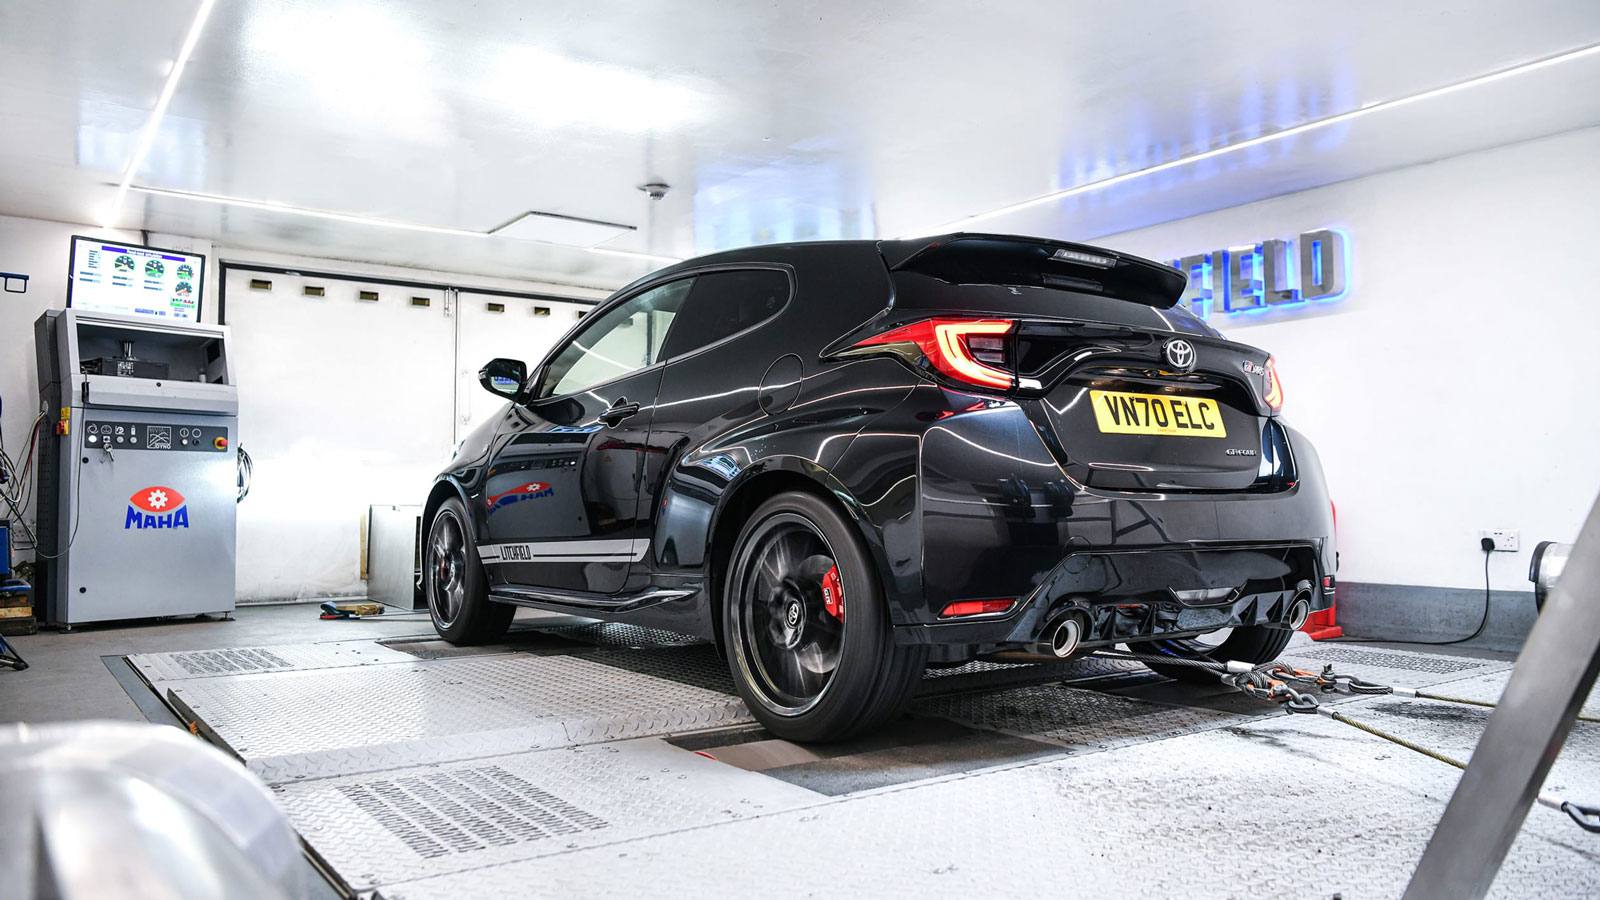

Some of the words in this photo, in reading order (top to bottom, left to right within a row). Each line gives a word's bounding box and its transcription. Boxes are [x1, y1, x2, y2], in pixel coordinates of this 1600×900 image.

[1165, 228, 1339, 316] FIELD
[1103, 395, 1168, 428] VN70
[1169, 399, 1215, 430] ELC
[124, 504, 189, 529] MAHA
[499, 545, 532, 561] LITCHFIELD
